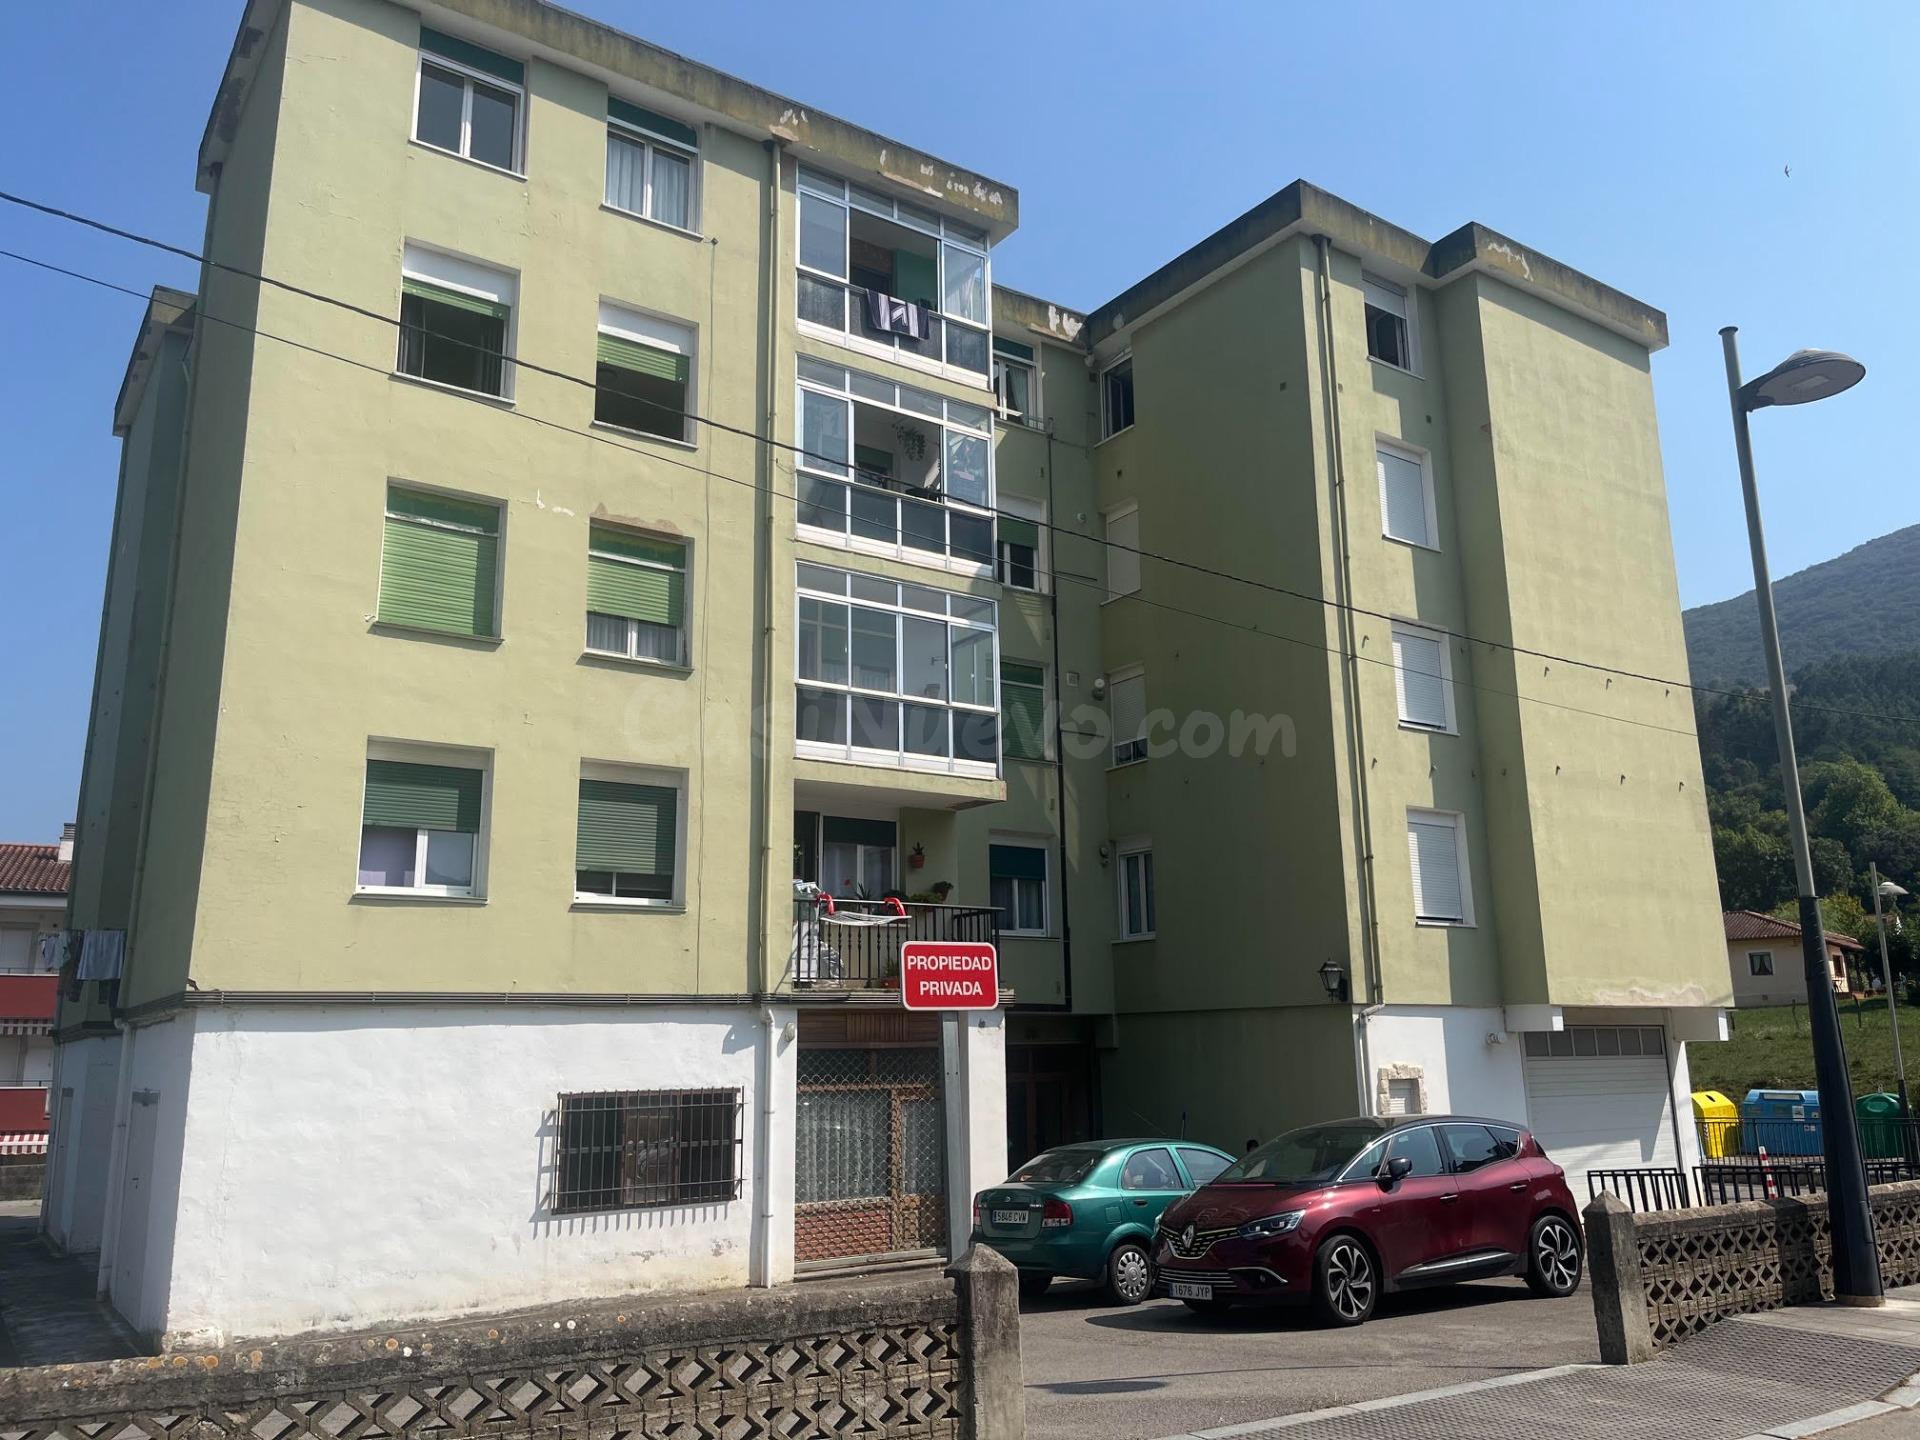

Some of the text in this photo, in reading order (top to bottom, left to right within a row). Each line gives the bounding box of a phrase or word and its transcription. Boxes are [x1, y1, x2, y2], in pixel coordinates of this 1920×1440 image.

[907, 955, 992, 971] PROPIEDAD
[919, 981, 983, 996] PRIVADA
[1195, 1286, 1210, 1298] JYP
